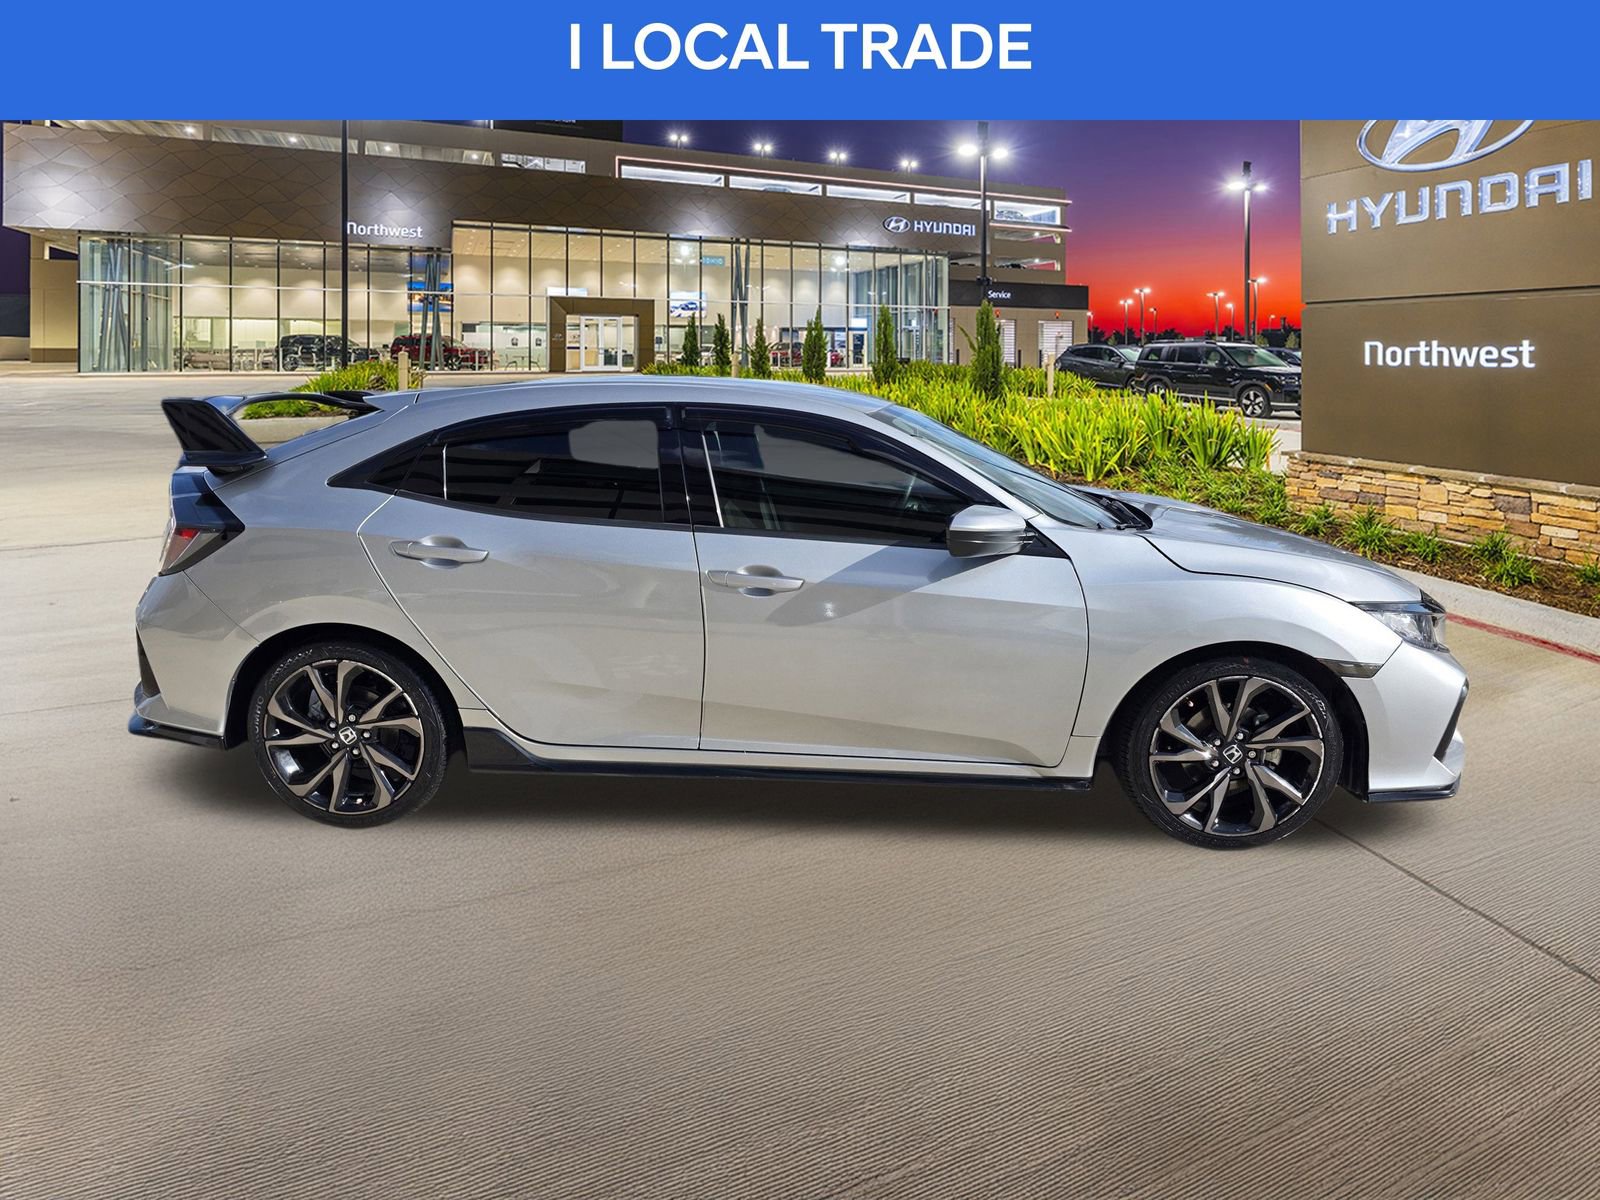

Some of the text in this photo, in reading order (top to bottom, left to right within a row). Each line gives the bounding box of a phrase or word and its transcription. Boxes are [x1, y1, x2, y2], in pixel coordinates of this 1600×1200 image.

[1326, 158, 1593, 235] HYUNDAI
[346, 221, 424, 238] Northwest
[913, 220, 976, 237] HYUNDAI
[987, 290, 1011, 299] Service
[1363, 339, 1537, 369] Northwest
